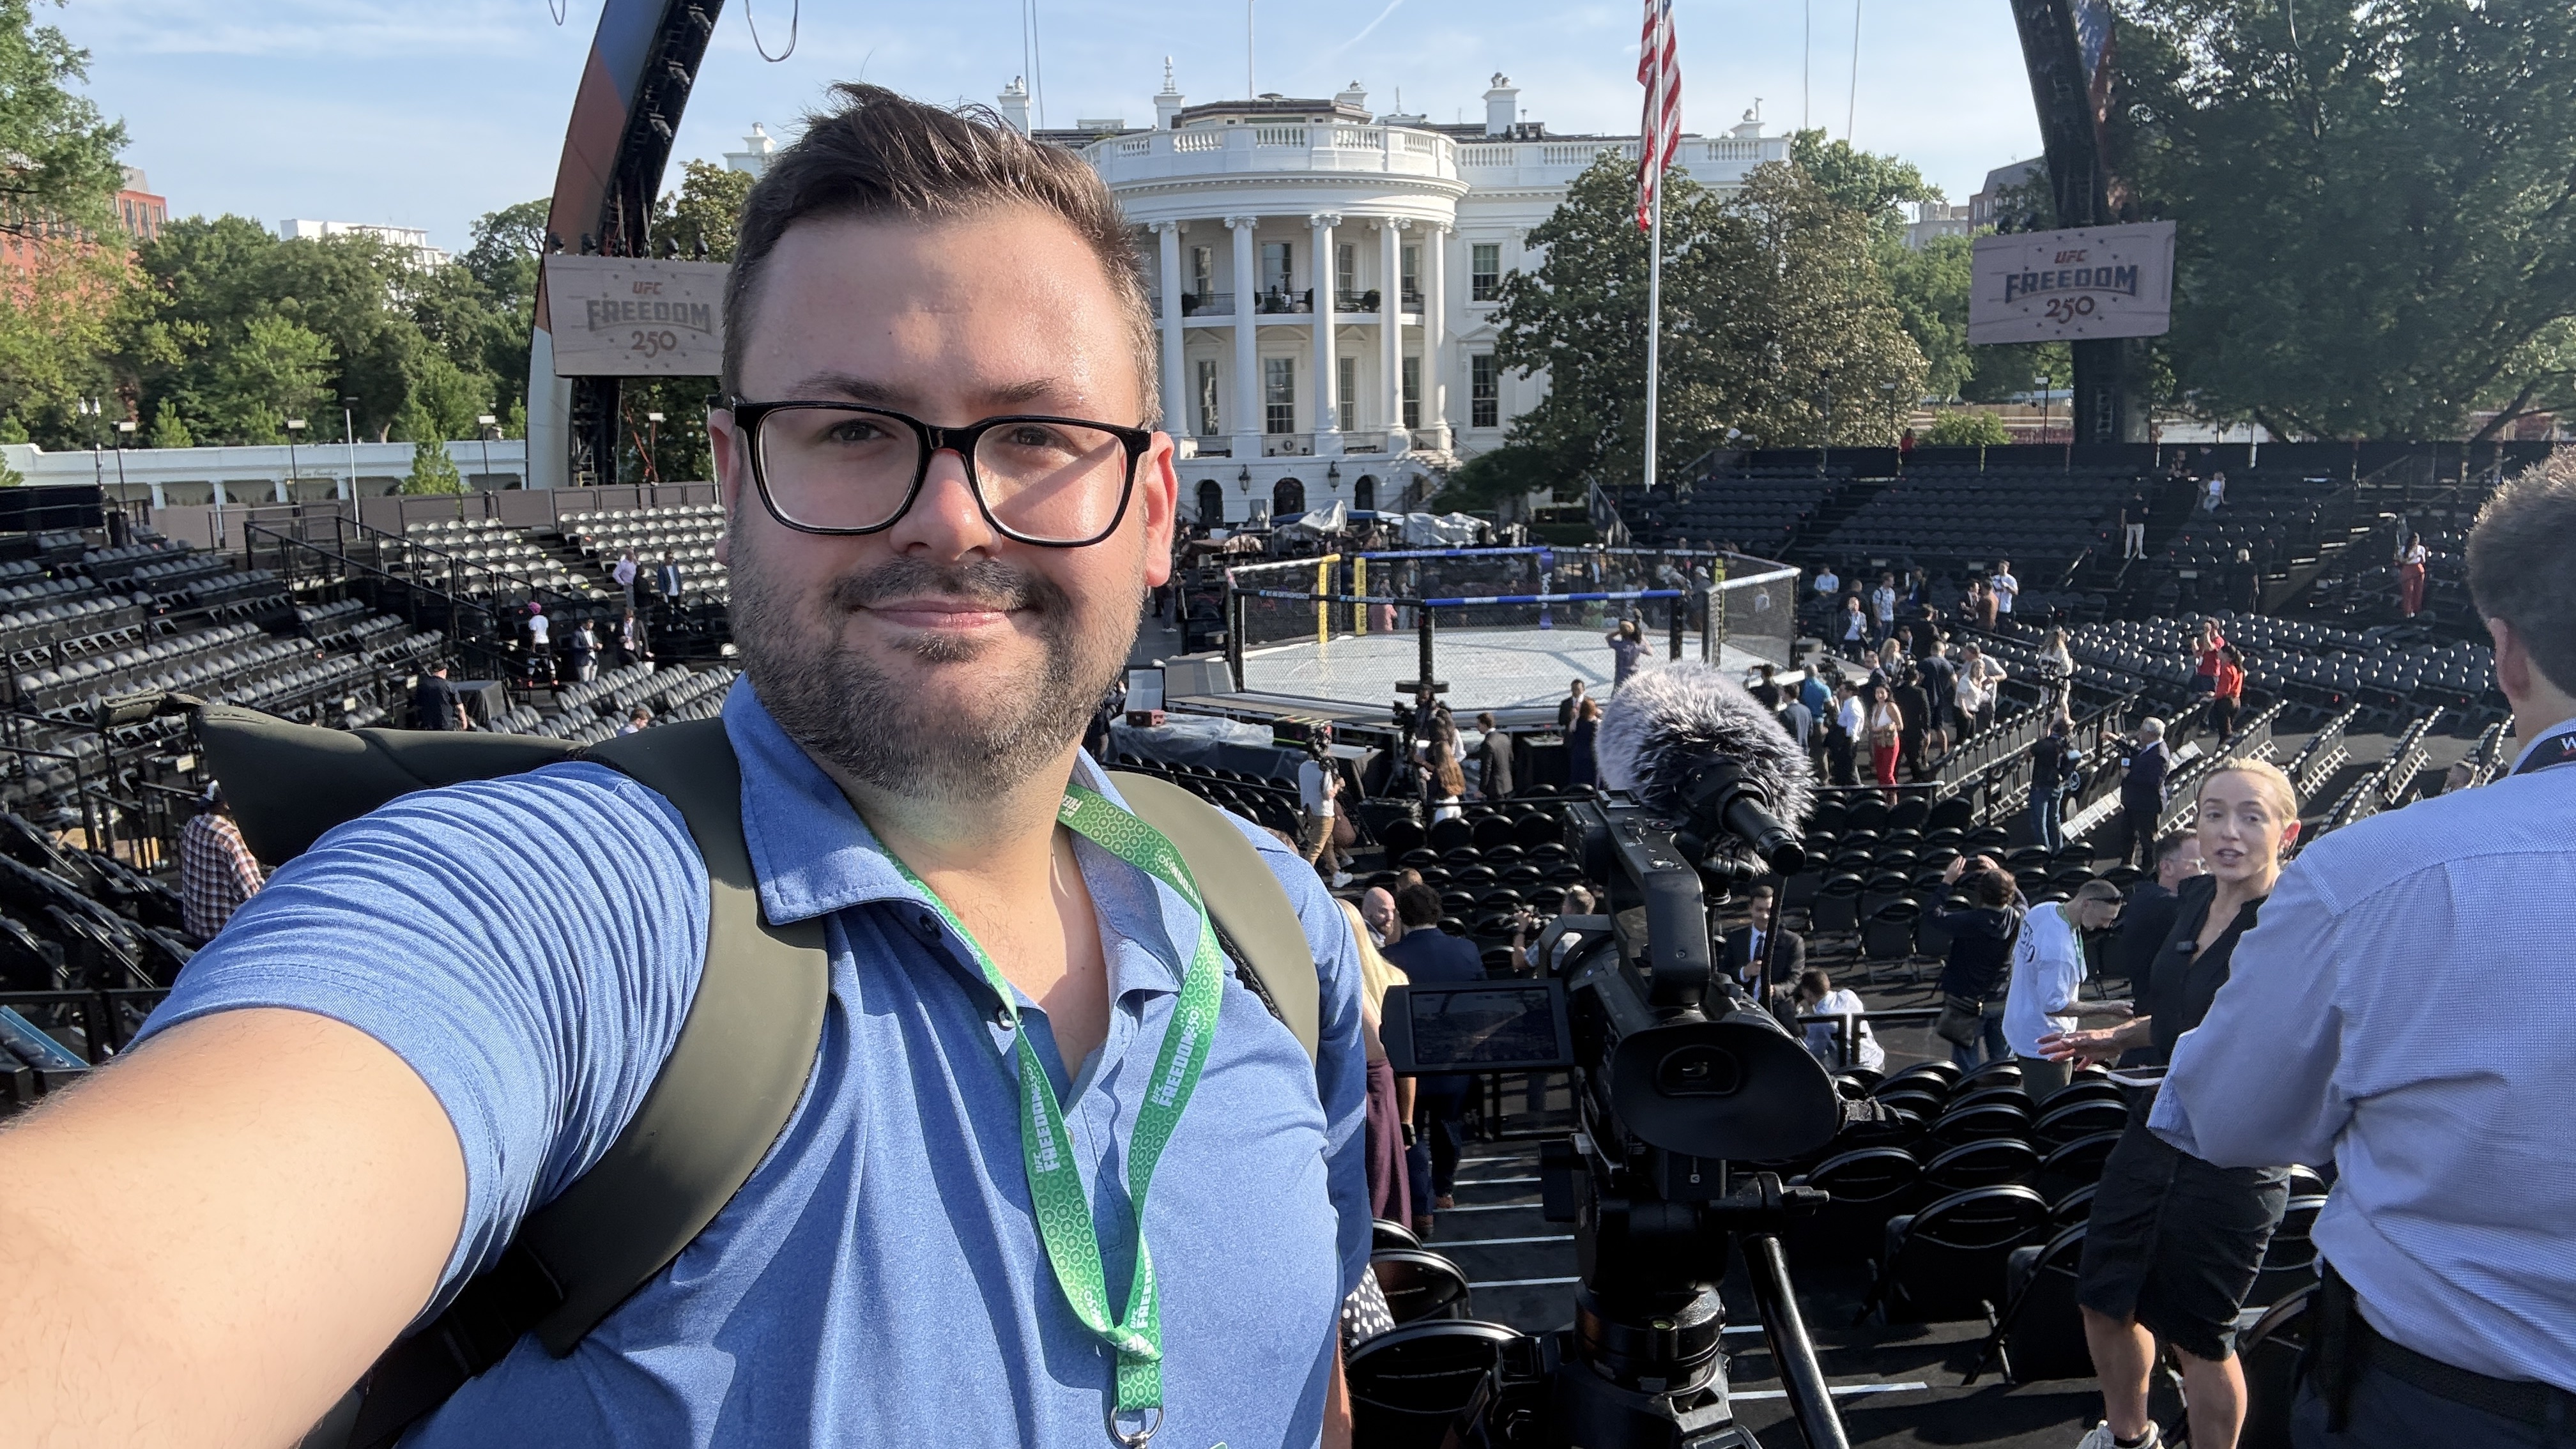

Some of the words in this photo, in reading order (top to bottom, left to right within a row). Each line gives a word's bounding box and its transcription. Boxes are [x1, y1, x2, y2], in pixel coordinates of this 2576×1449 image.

[2055, 249, 2088, 264] UFC
[632, 281, 664, 295] UFC
[2005, 264, 2138, 303] FREEDOM
[586, 300, 712, 335] FREEDOM
[2044, 296, 2095, 324] 250
[631, 330, 677, 358] 250
[1158, 1033, 1195, 1107] FREEDOM
[1183, 1010, 1199, 1036] 250
[1151, 1082, 1163, 1103] UFC
[1033, 1152, 1044, 1172] UFC
[1130, 1308, 1138, 1328] UFC
